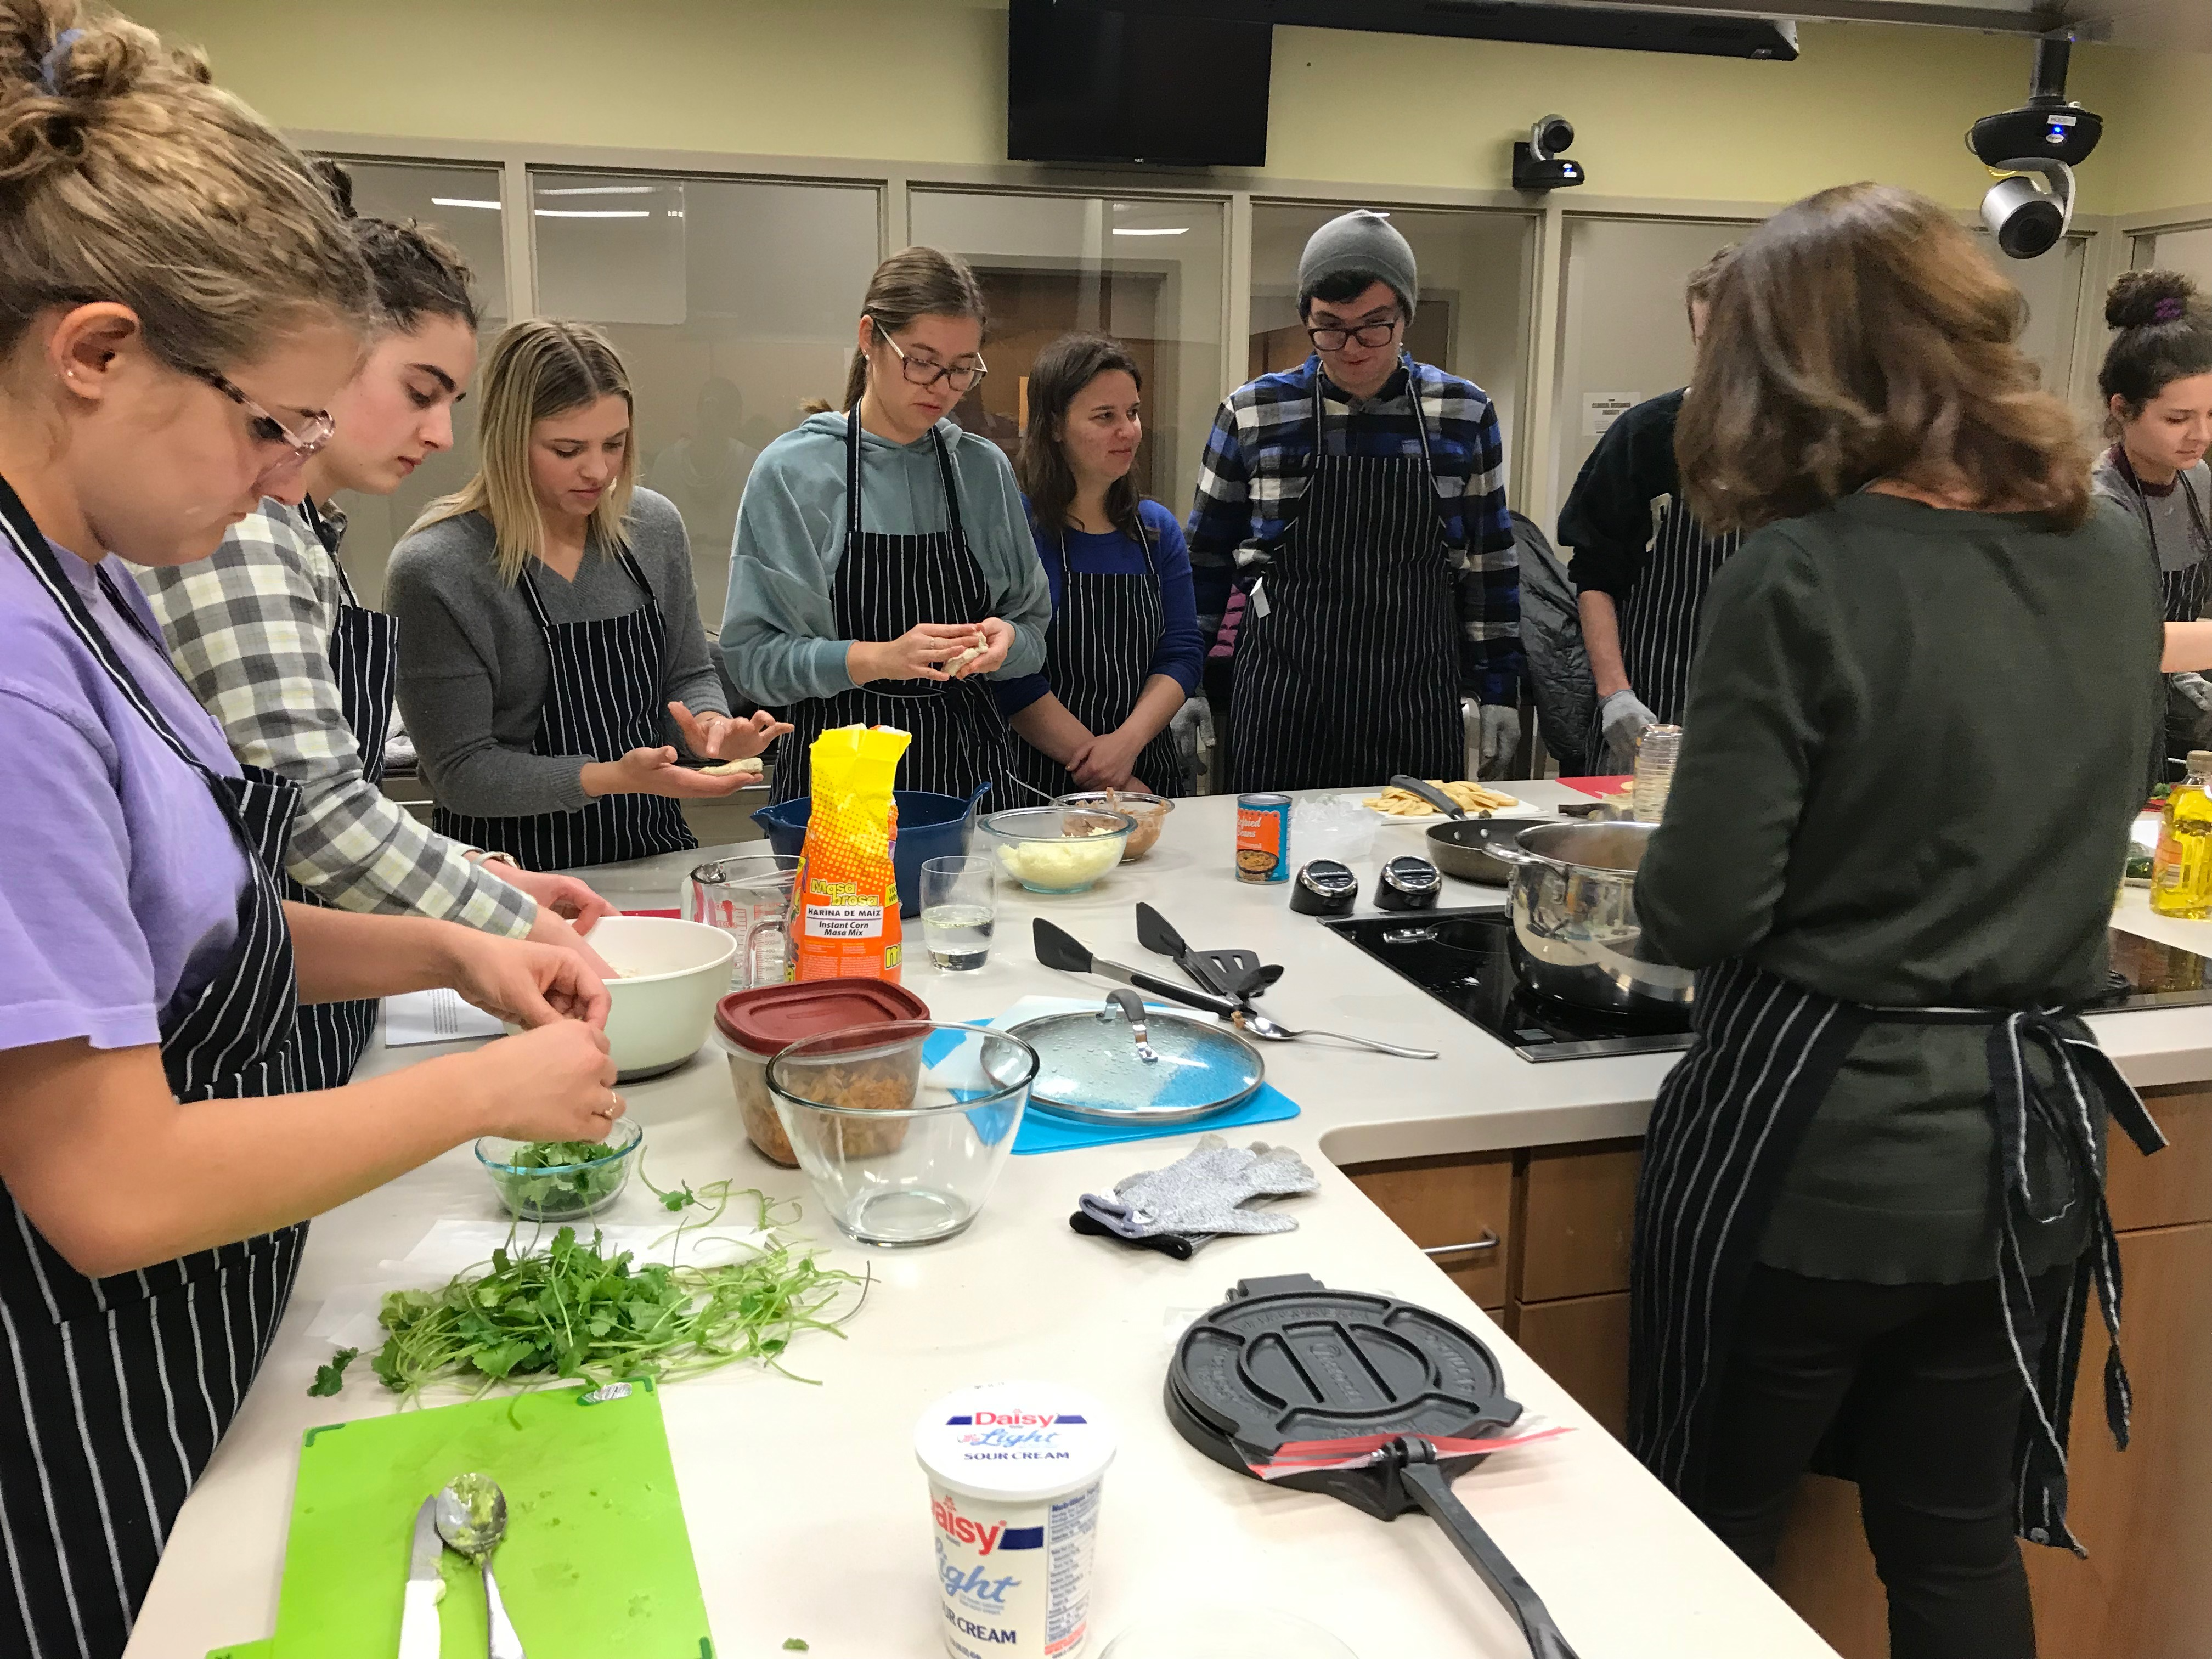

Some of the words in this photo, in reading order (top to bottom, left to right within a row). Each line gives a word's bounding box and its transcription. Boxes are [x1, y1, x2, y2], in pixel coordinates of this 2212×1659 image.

[831, 894, 878, 907] brosa
[808, 908, 841, 917] HARINA
[819, 921, 848, 929] Instant
[824, 928, 847, 936] Masa
[848, 928, 864, 936] Mix
[975, 1409, 1054, 1428] Daisy
[970, 1427, 1060, 1448] Light
[964, 1452, 1008, 1460] SOUR
[1011, 1452, 1070, 1460] CREAM
[931, 1494, 1000, 1556] aisy
[957, 1617, 1017, 1644] CREAM
